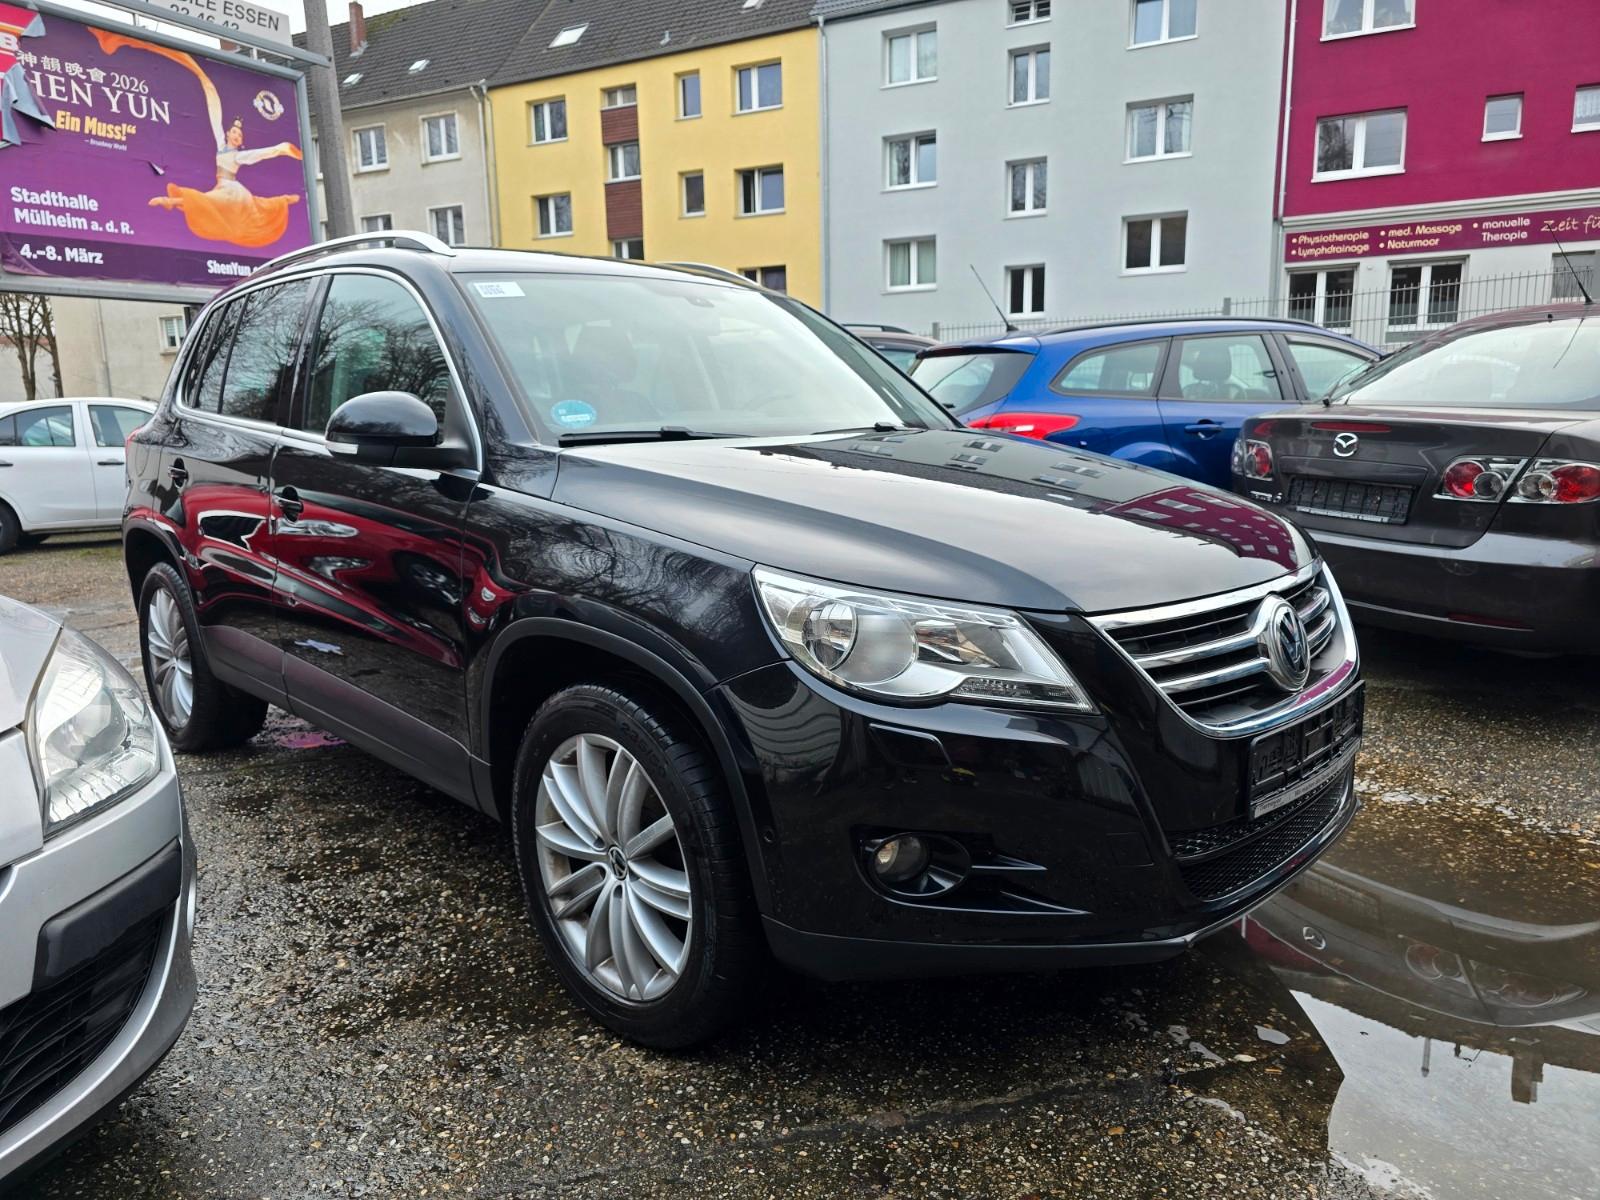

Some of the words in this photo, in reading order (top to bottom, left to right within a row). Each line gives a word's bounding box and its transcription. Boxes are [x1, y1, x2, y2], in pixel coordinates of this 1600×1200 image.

[223, 1, 279, 31] ESSEN
[110, 72, 149, 95] 2026
[30, 70, 93, 107] HEN
[102, 86, 170, 124] YUN
[56, 110, 81, 133] Ein
[10, 186, 99, 212] Stadthalle
[14, 207, 89, 230] Mülheim
[90, 221, 104, 231] a.
[105, 220, 119, 233] d.
[120, 222, 135, 235] R.
[1388, 226, 1413, 237] med.
[1415, 223, 1462, 236] Massage
[1482, 217, 1531, 230] manuelle
[1298, 231, 1369, 246] Physiotherapie
[1387, 238, 1440, 250] Naturmoor
[1482, 230, 1528, 242] Therapie
[64, 246, 104, 264] März
[1298, 243, 1370, 258] Lymphdrainage
